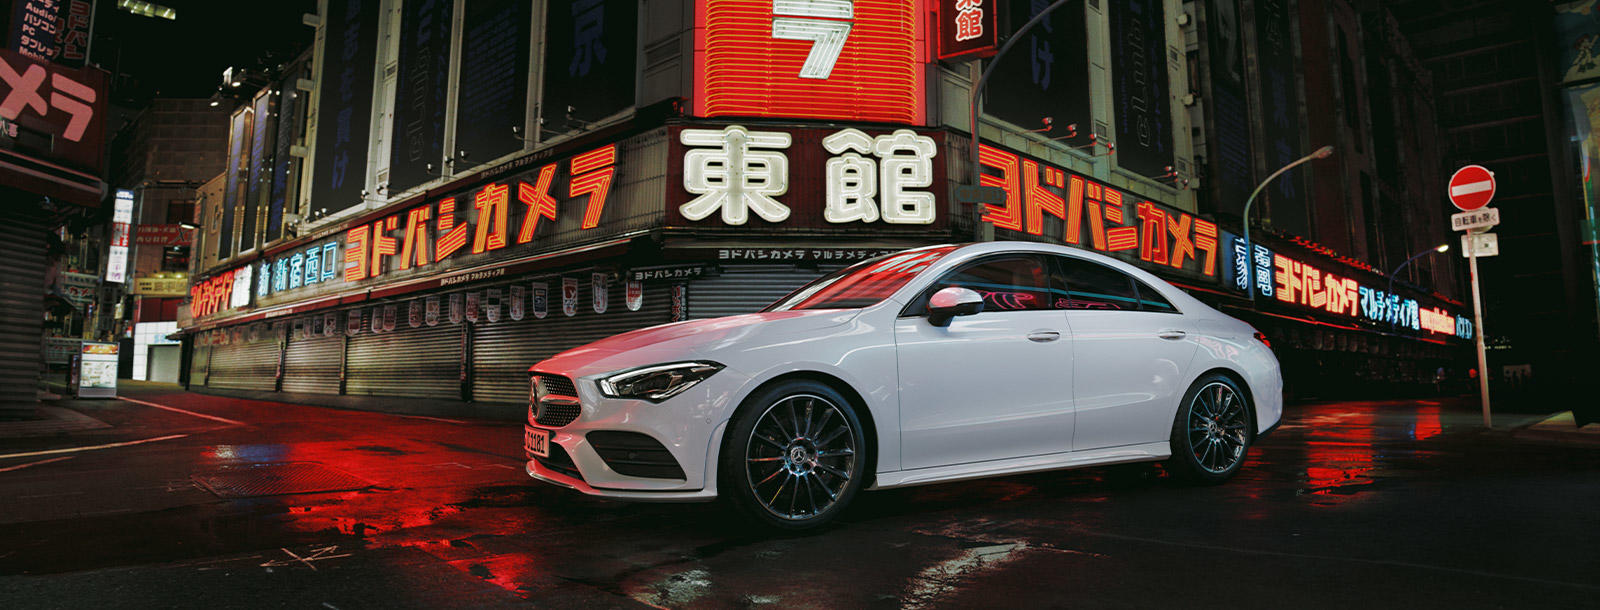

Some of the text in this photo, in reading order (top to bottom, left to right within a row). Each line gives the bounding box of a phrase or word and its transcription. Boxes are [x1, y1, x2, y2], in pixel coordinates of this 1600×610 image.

[22, 23, 36, 37] PC
[24, 13, 56, 35] パソコン
[344, 142, 616, 283] ヨドバシカメラ
[978, 142, 1219, 278] ヨドバシカメラ
[719, 249, 797, 261] ヨドバシカメラ
[635, 267, 703, 281] ヨドバシカメラ
[1273, 252, 1359, 319] ヨドバシカメラ
